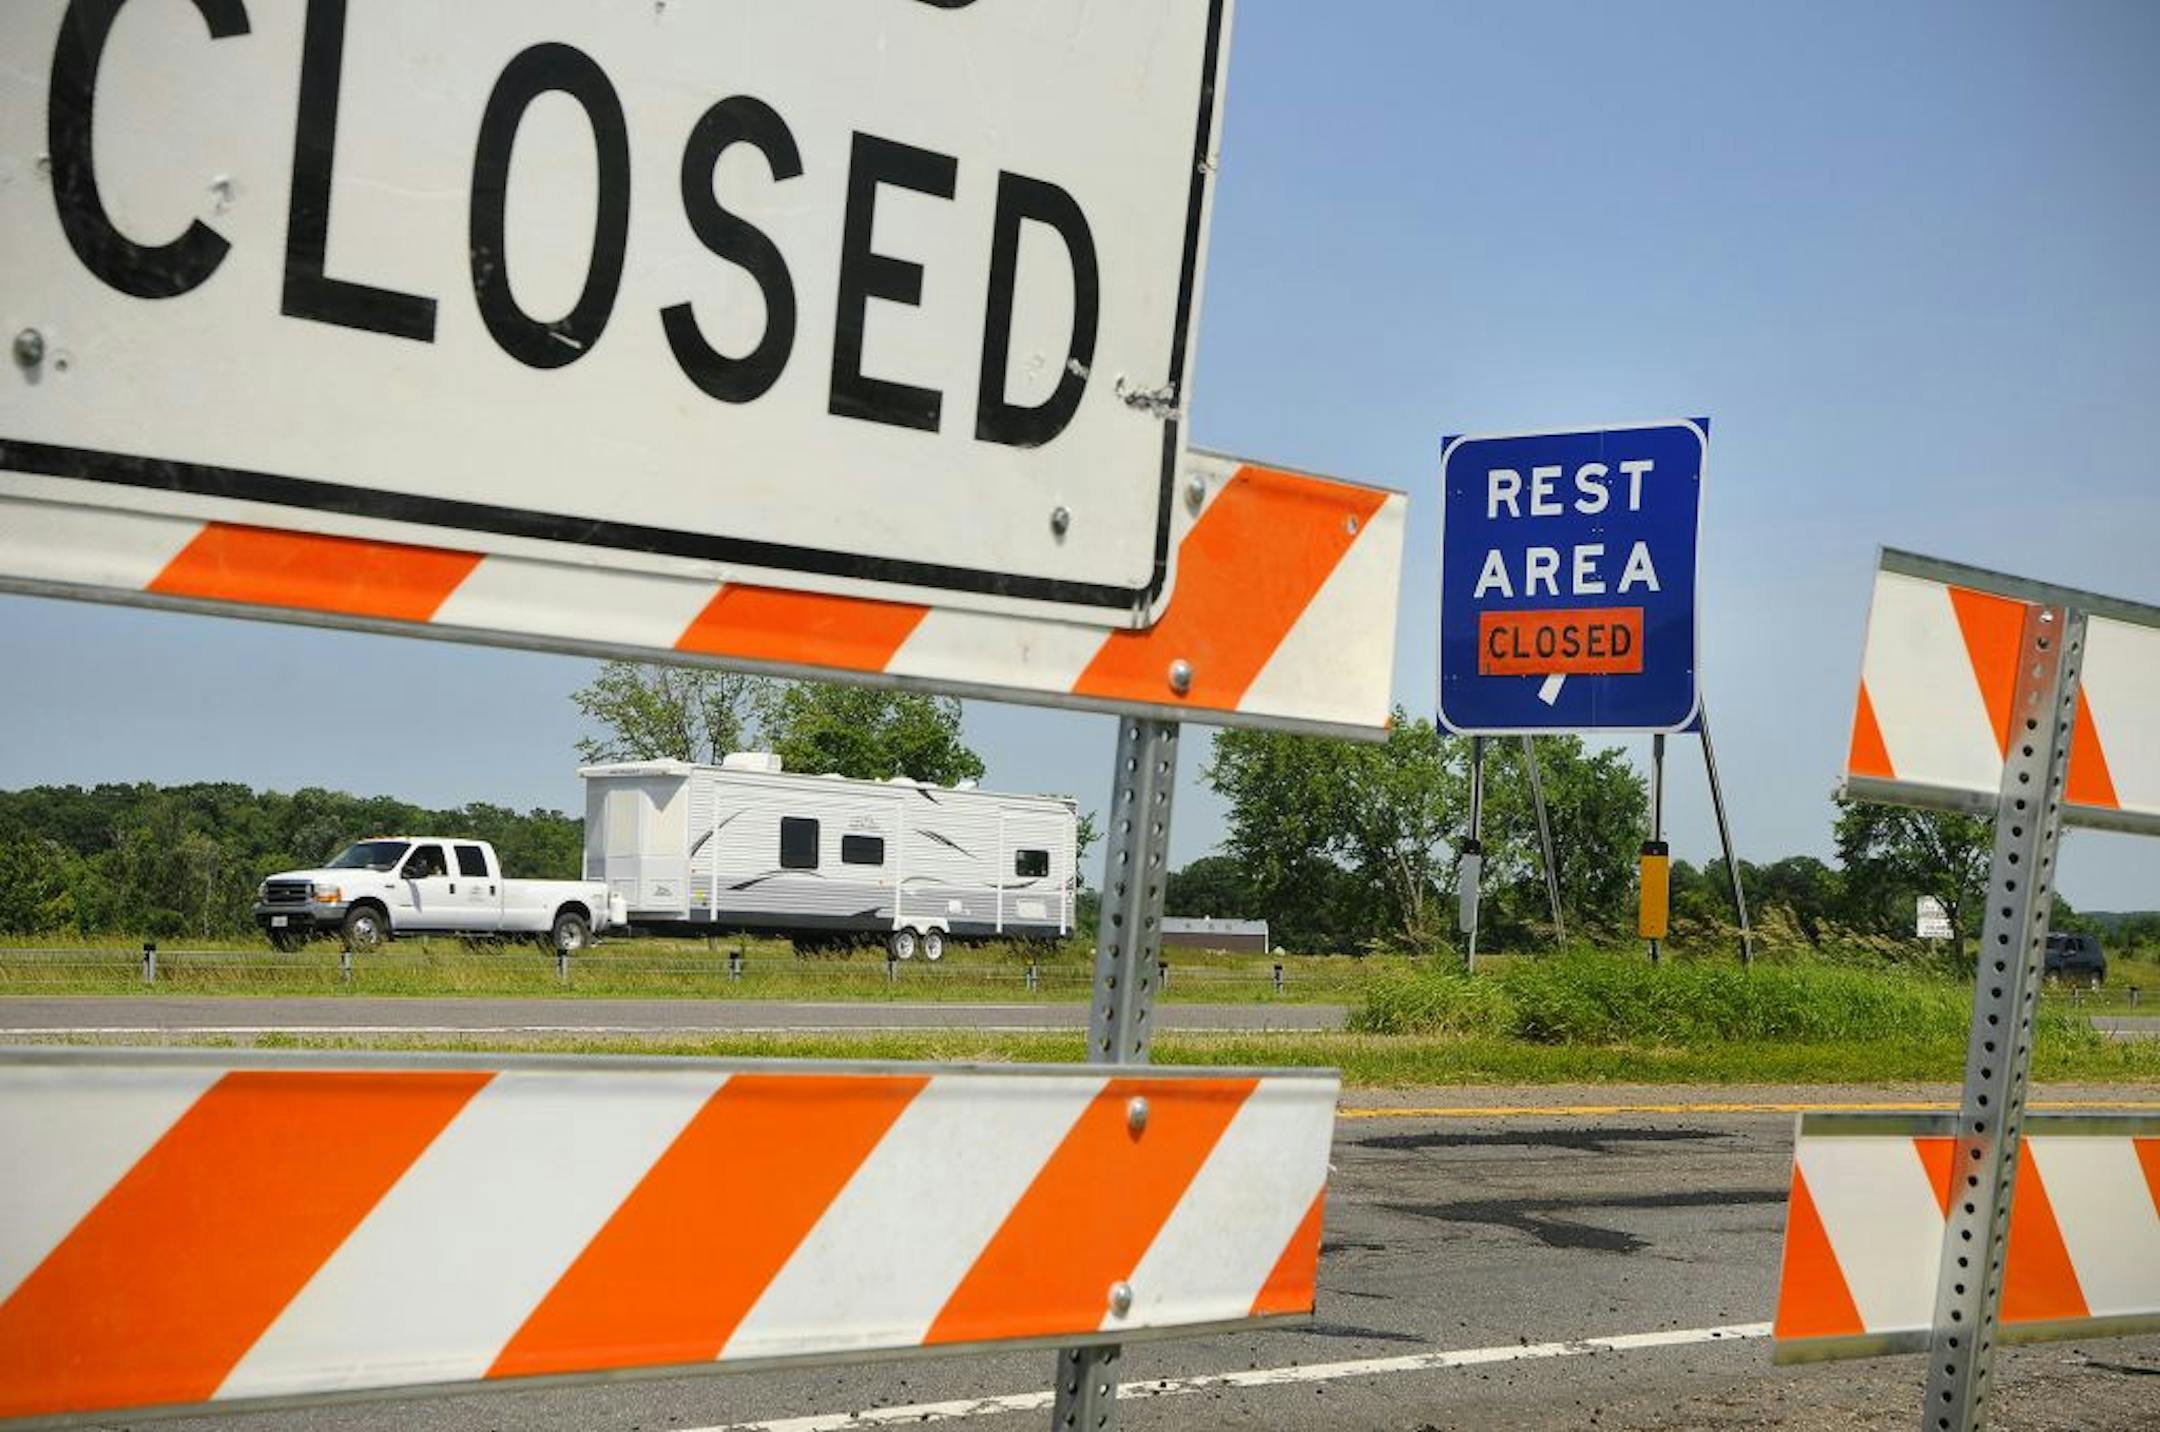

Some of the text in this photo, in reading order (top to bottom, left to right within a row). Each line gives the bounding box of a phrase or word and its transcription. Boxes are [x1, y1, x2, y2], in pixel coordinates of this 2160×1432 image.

[48, 0, 1100, 448] CLOSED
[1487, 459, 1654, 519] REST
[1473, 540, 1661, 599] AREA
[1487, 623, 1632, 661] CLOSED
